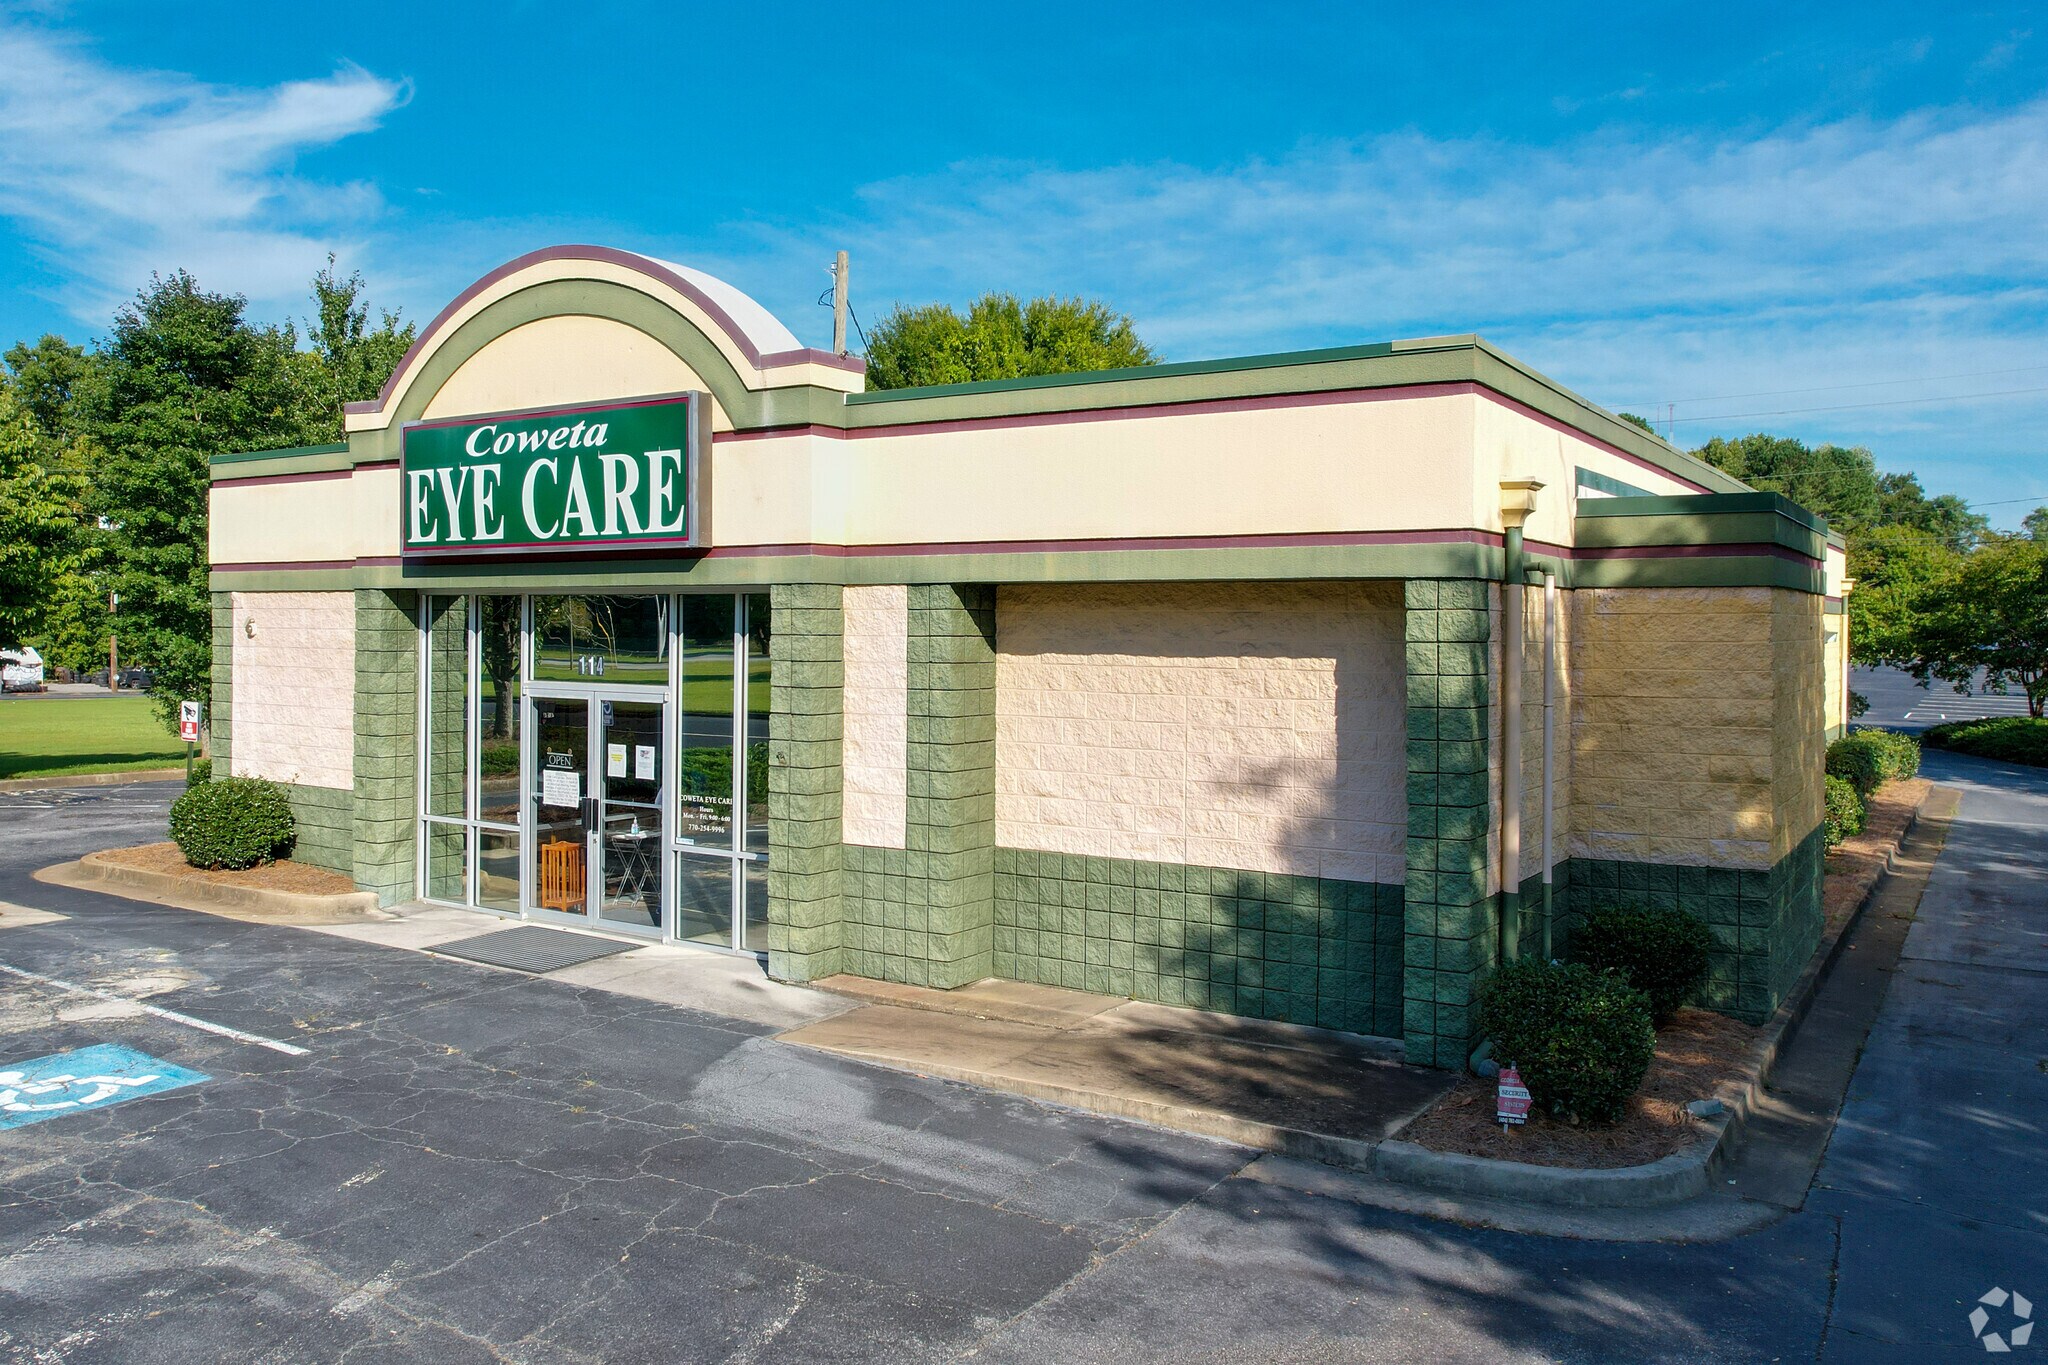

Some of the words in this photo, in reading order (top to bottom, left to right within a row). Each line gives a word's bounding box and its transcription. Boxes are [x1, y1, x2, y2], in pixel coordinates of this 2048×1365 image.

[465, 420, 609, 457] Coweta
[407, 463, 505, 543] EYE
[521, 449, 685, 539] CARE
[579, 656, 603, 675] 114
[548, 755, 571, 766] OPEN
